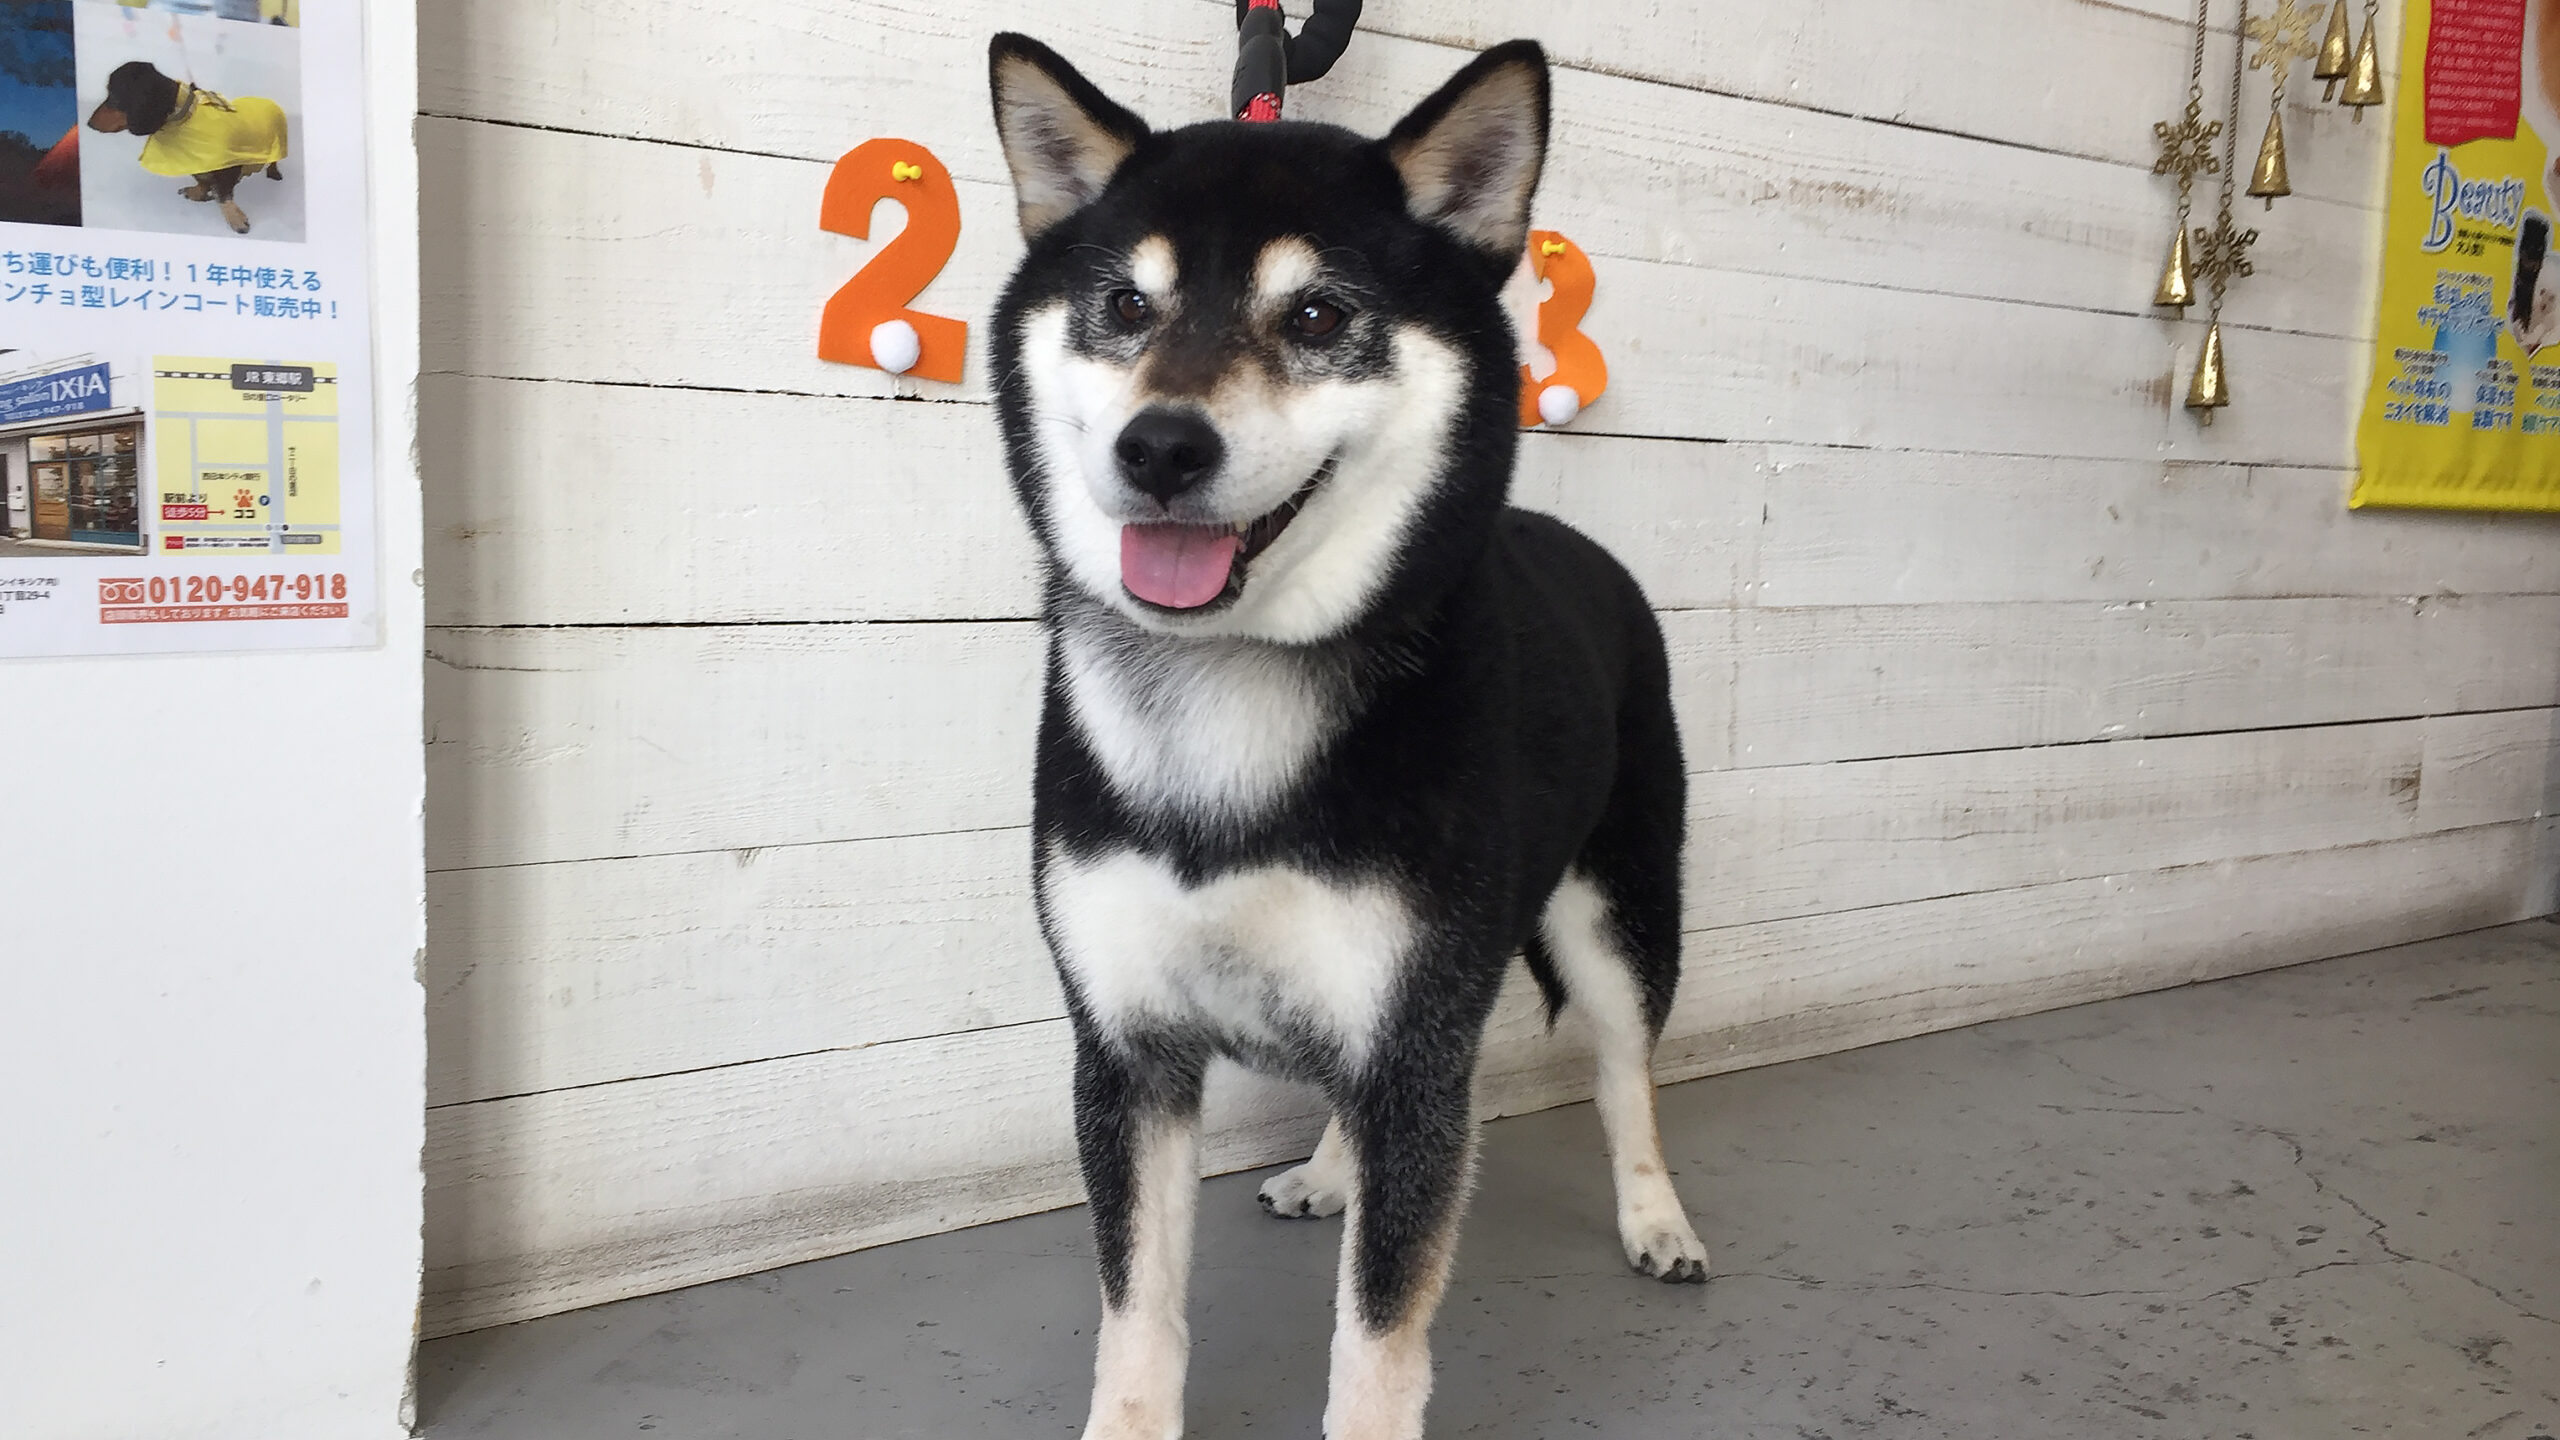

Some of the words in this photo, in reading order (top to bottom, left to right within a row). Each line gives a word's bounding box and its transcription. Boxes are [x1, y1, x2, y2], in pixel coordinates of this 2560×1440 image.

[818, 138, 967, 384] 2
[51, 372, 107, 402] IXIA
[233, 509, 255, 519] ココ
[149, 574, 347, 603] 0120-947-918
